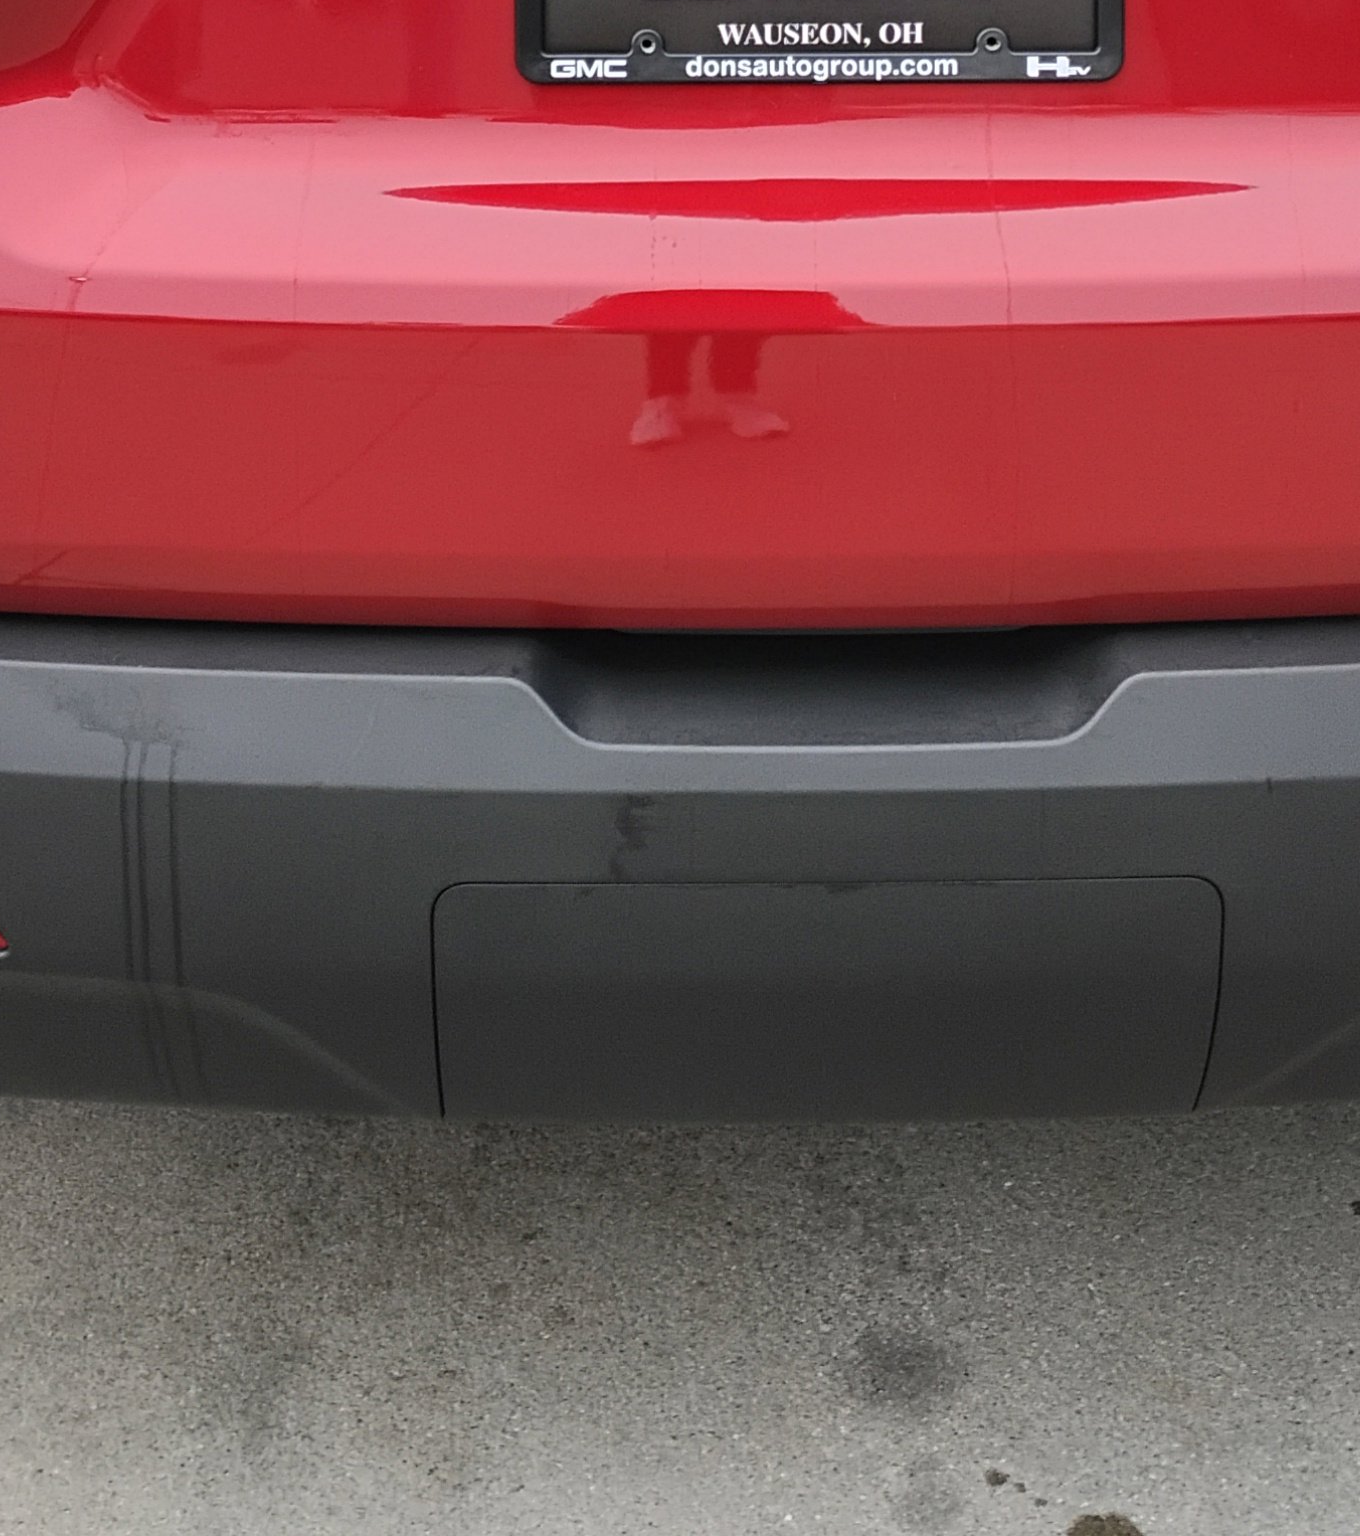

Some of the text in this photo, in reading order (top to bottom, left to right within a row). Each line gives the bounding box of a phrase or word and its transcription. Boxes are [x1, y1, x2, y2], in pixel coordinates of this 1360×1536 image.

[718, 22, 924, 47] WAUSEON, OH
[550, 59, 628, 79] GMC
[685, 55, 959, 82] donsautogroup.com
